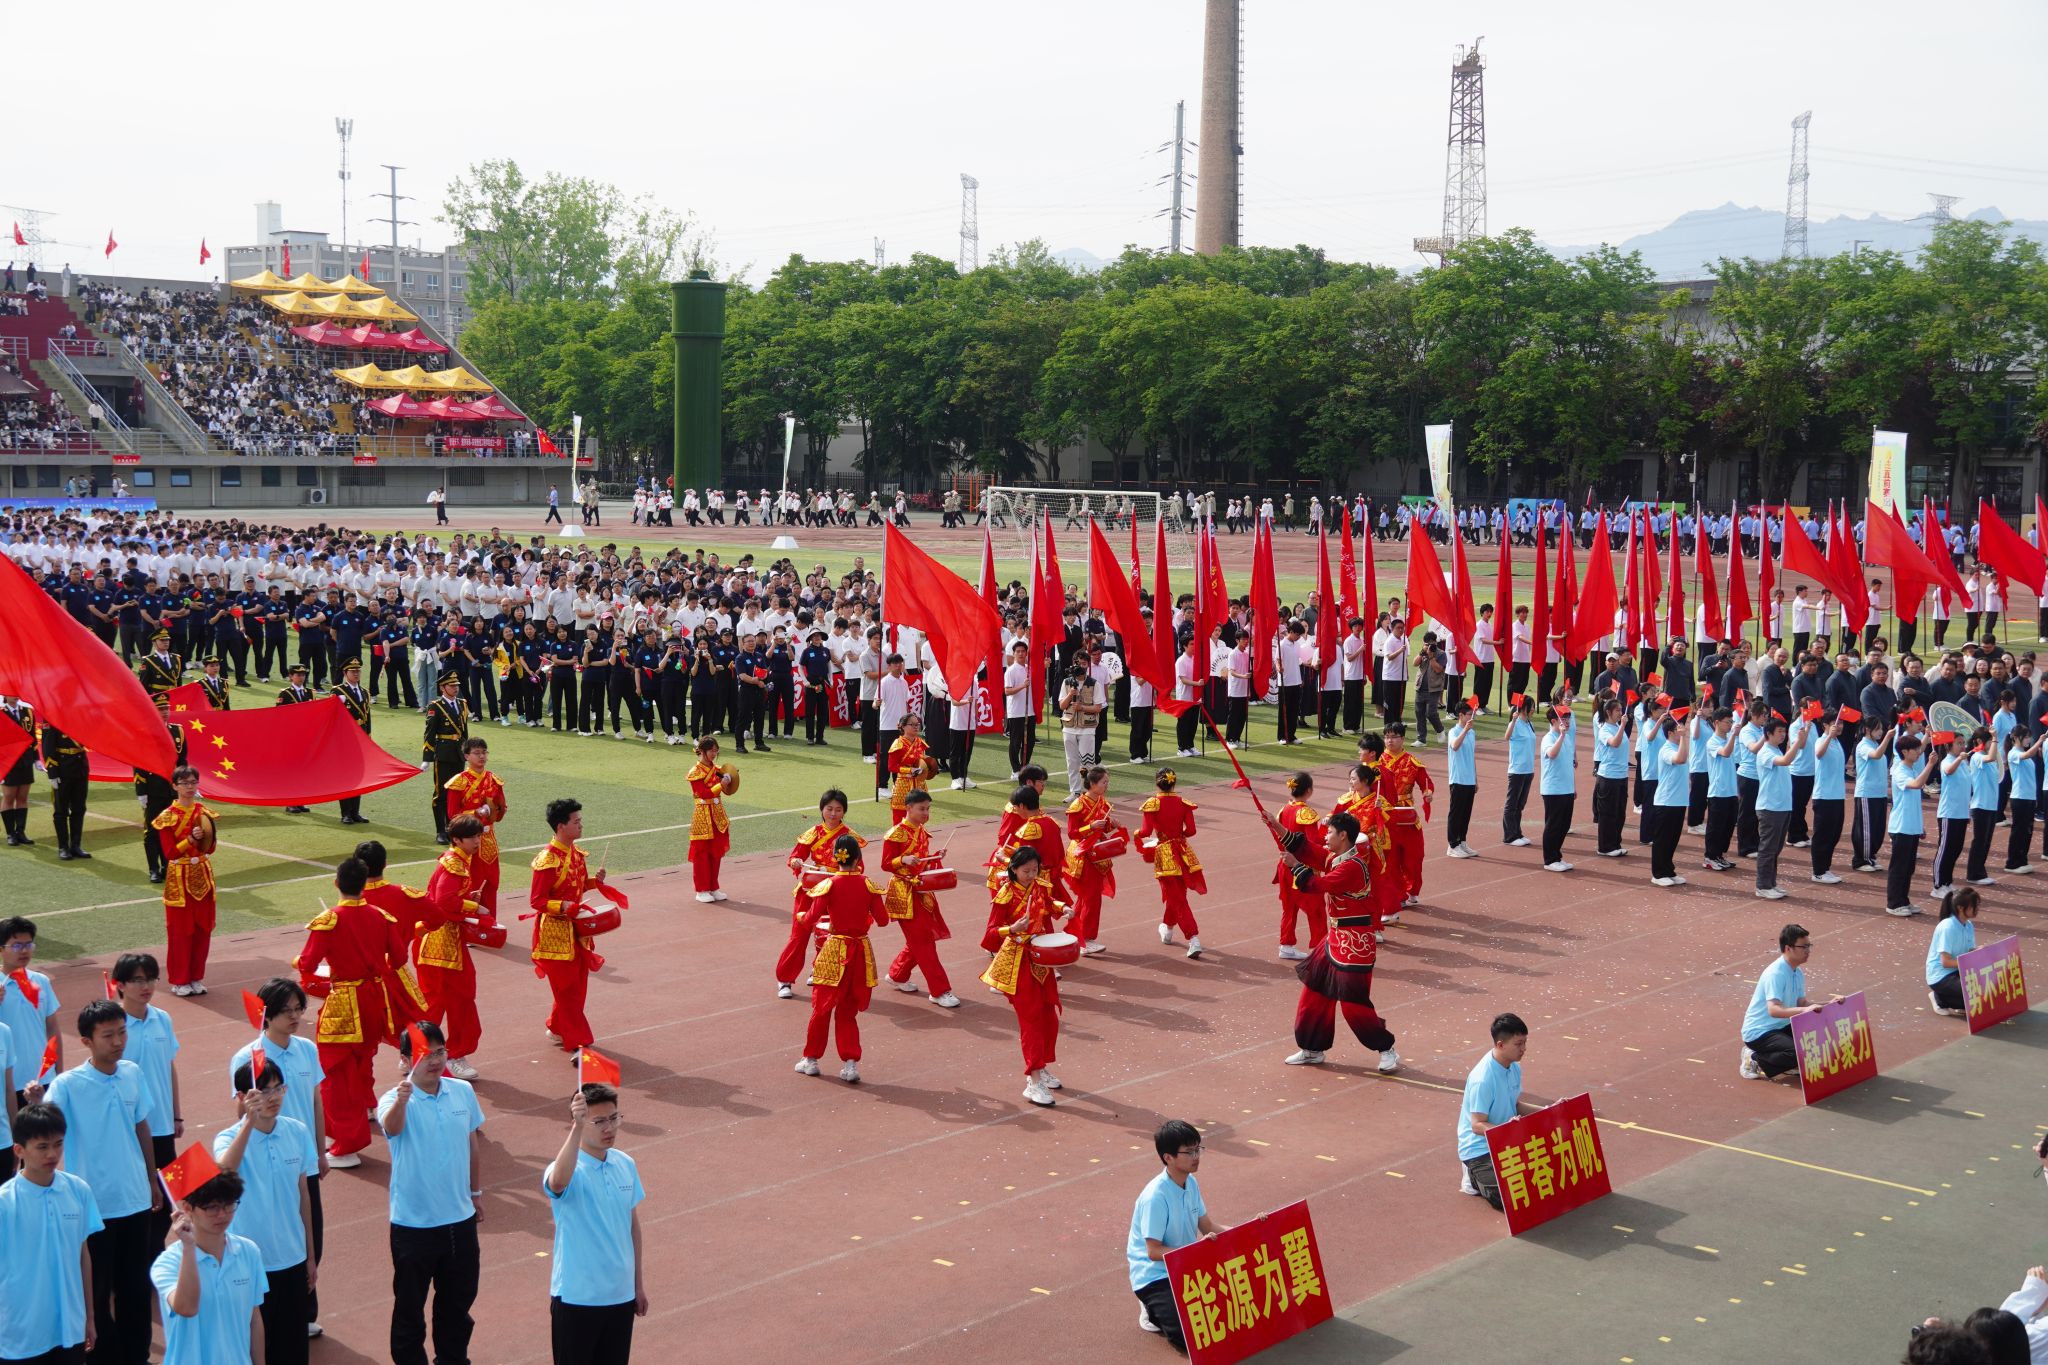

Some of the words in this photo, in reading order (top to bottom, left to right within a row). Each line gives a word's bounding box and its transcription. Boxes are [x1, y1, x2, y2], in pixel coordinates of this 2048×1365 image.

[1965, 952, 2024, 1018] 势不可挡
[1799, 1010, 1871, 1084] 凝心聚力
[1497, 1117, 1602, 1211] 青春为帆
[1182, 1226, 1321, 1351] 能源为翼
